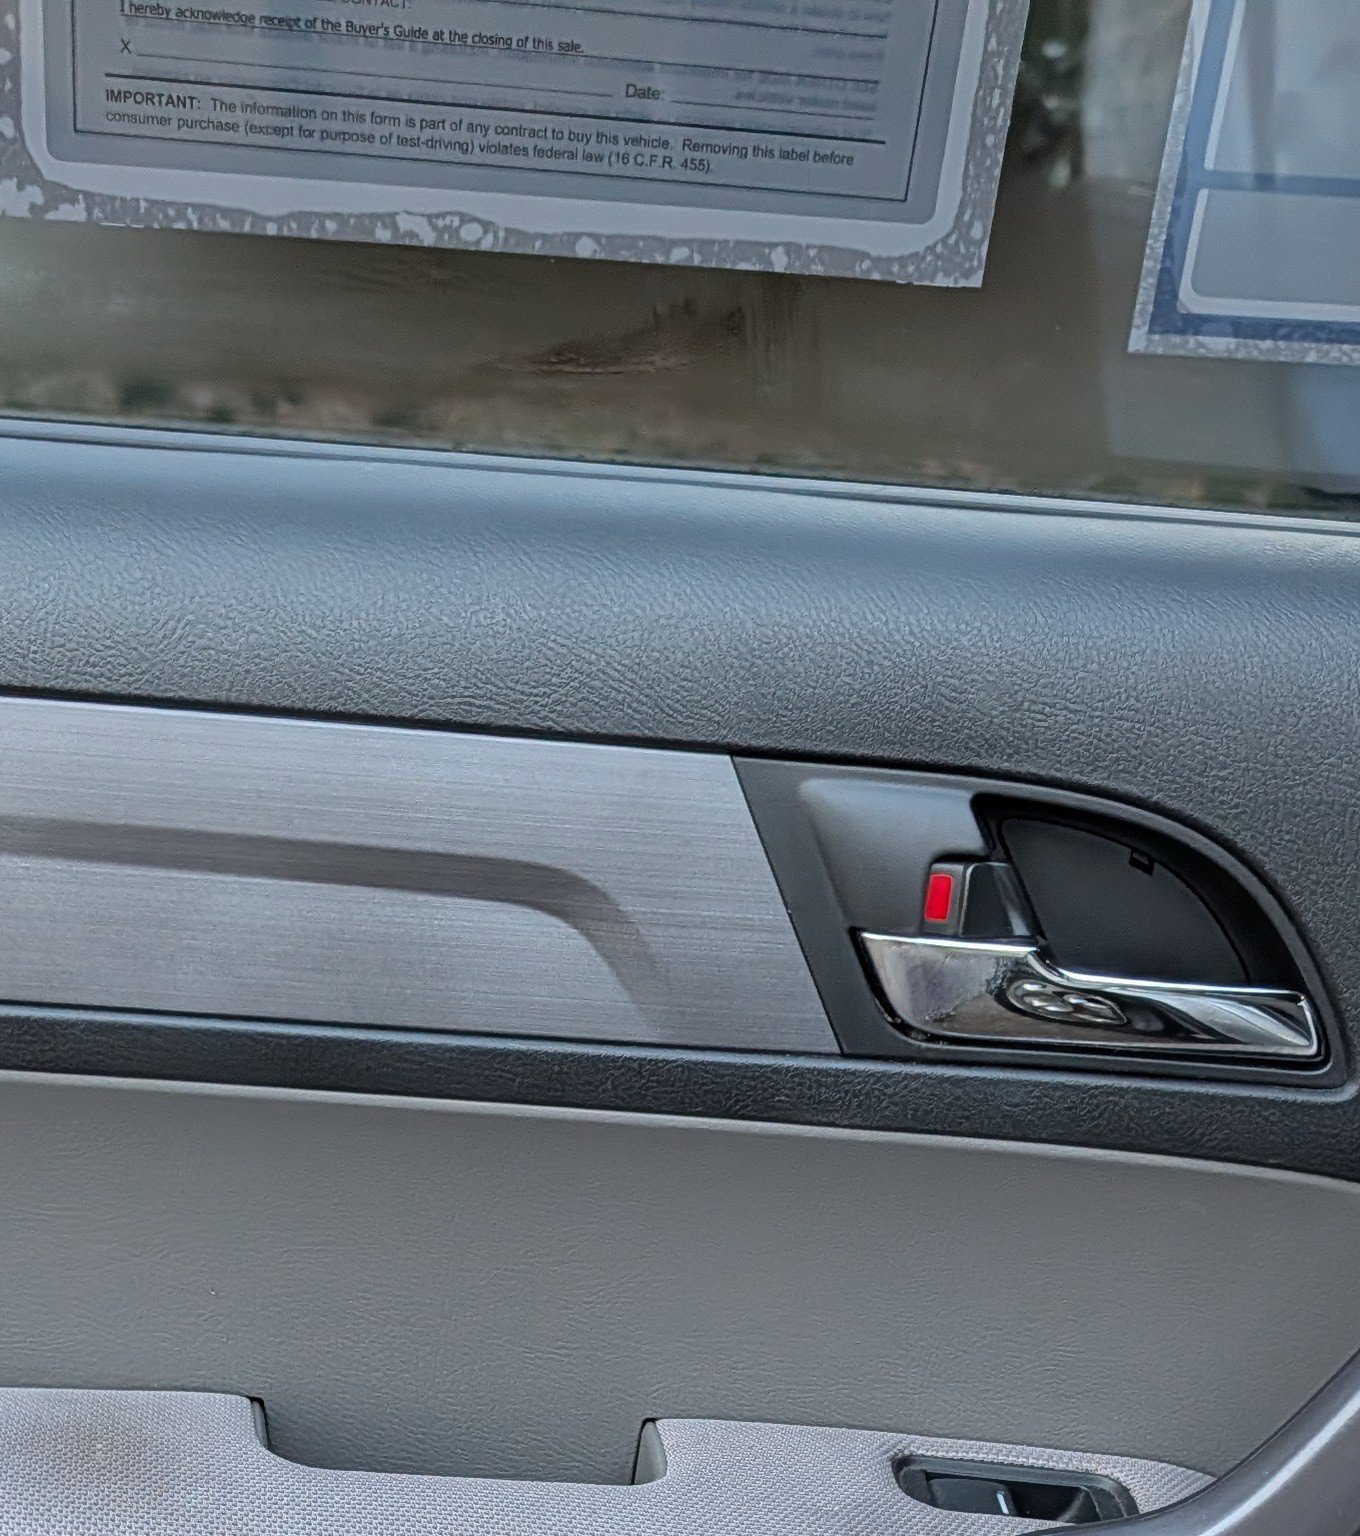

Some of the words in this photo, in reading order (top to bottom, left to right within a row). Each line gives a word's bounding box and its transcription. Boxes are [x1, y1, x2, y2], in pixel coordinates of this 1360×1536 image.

[120, 38, 132, 54] X
[129, 0, 171, 18] hereby
[175, 7, 256, 25] acknowledge
[259, 14, 302, 29] receipt
[304, 17, 318, 29] of
[321, 18, 342, 32] the
[345, 20, 390, 37] Buyer's
[393, 24, 429, 40] Guide
[432, 29, 445, 42] at
[448, 29, 469, 43] the
[471, 32, 513, 49] closing
[516, 35, 530, 48] of
[532, 37, 554, 51] this
[557, 40, 585, 54] sale.
[624, 83, 664, 100] Date:
[105, 88, 202, 110] IMPORTANT:
[211, 97, 237, 114] The
[241, 100, 317, 120] information
[321, 109, 339, 121] on
[342, 110, 367, 125] this
[370, 111, 401, 127] form
[405, 115, 416, 128] is
[420, 116, 446, 132] part
[449, 118, 463, 132] of
[466, 122, 490, 140] any
[494, 123, 548, 140] contract
[551, 127, 565, 141] to
[568, 128, 592, 147] buy
[595, 130, 619, 145] this
[623, 132, 673, 151] vehicle.
[682, 138, 748, 159] Removing
[752, 145, 776, 160] this
[778, 146, 810, 162] label
[812, 149, 855, 166] before
[105, 109, 172, 126] consumer
[177, 114, 240, 134] purchase
[244, 119, 294, 139] (except
[298, 124, 316, 139] for
[320, 128, 376, 145] purpose
[379, 131, 393, 146] of
[396, 133, 475, 156] test-driving)
[478, 141, 529, 158] violates
[532, 144, 579, 161] federal
[582, 147, 604, 164] law
[608, 152, 630, 168] (16
[633, 154, 676, 171] C.F.R.
